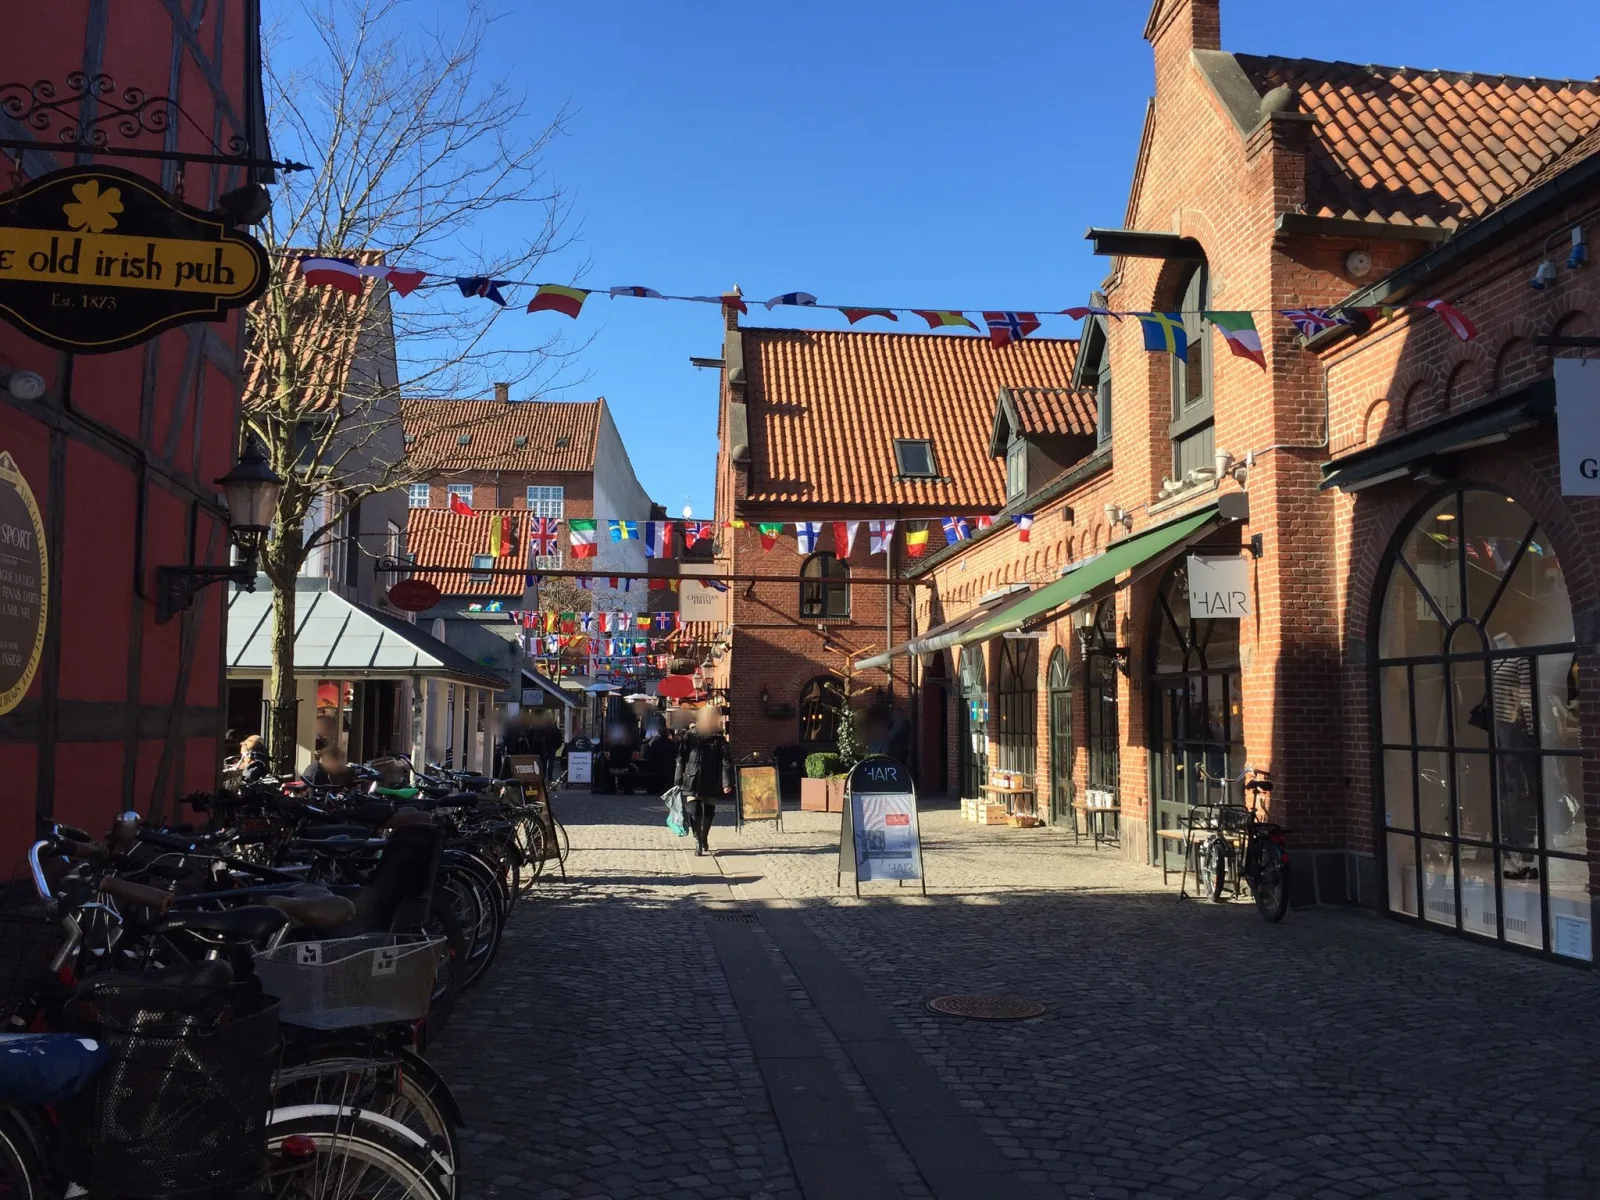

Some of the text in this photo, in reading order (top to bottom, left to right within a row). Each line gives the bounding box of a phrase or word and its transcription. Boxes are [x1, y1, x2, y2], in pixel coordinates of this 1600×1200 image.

[28, 236, 83, 275] old
[95, 242, 162, 281] irish
[174, 248, 236, 288] pub
[51, 292, 76, 308] Est.
[1, 523, 32, 551] SPORT
[1193, 591, 1248, 614] HAIR
[864, 766, 898, 781] HAIR
[887, 863, 914, 875] HAIR
